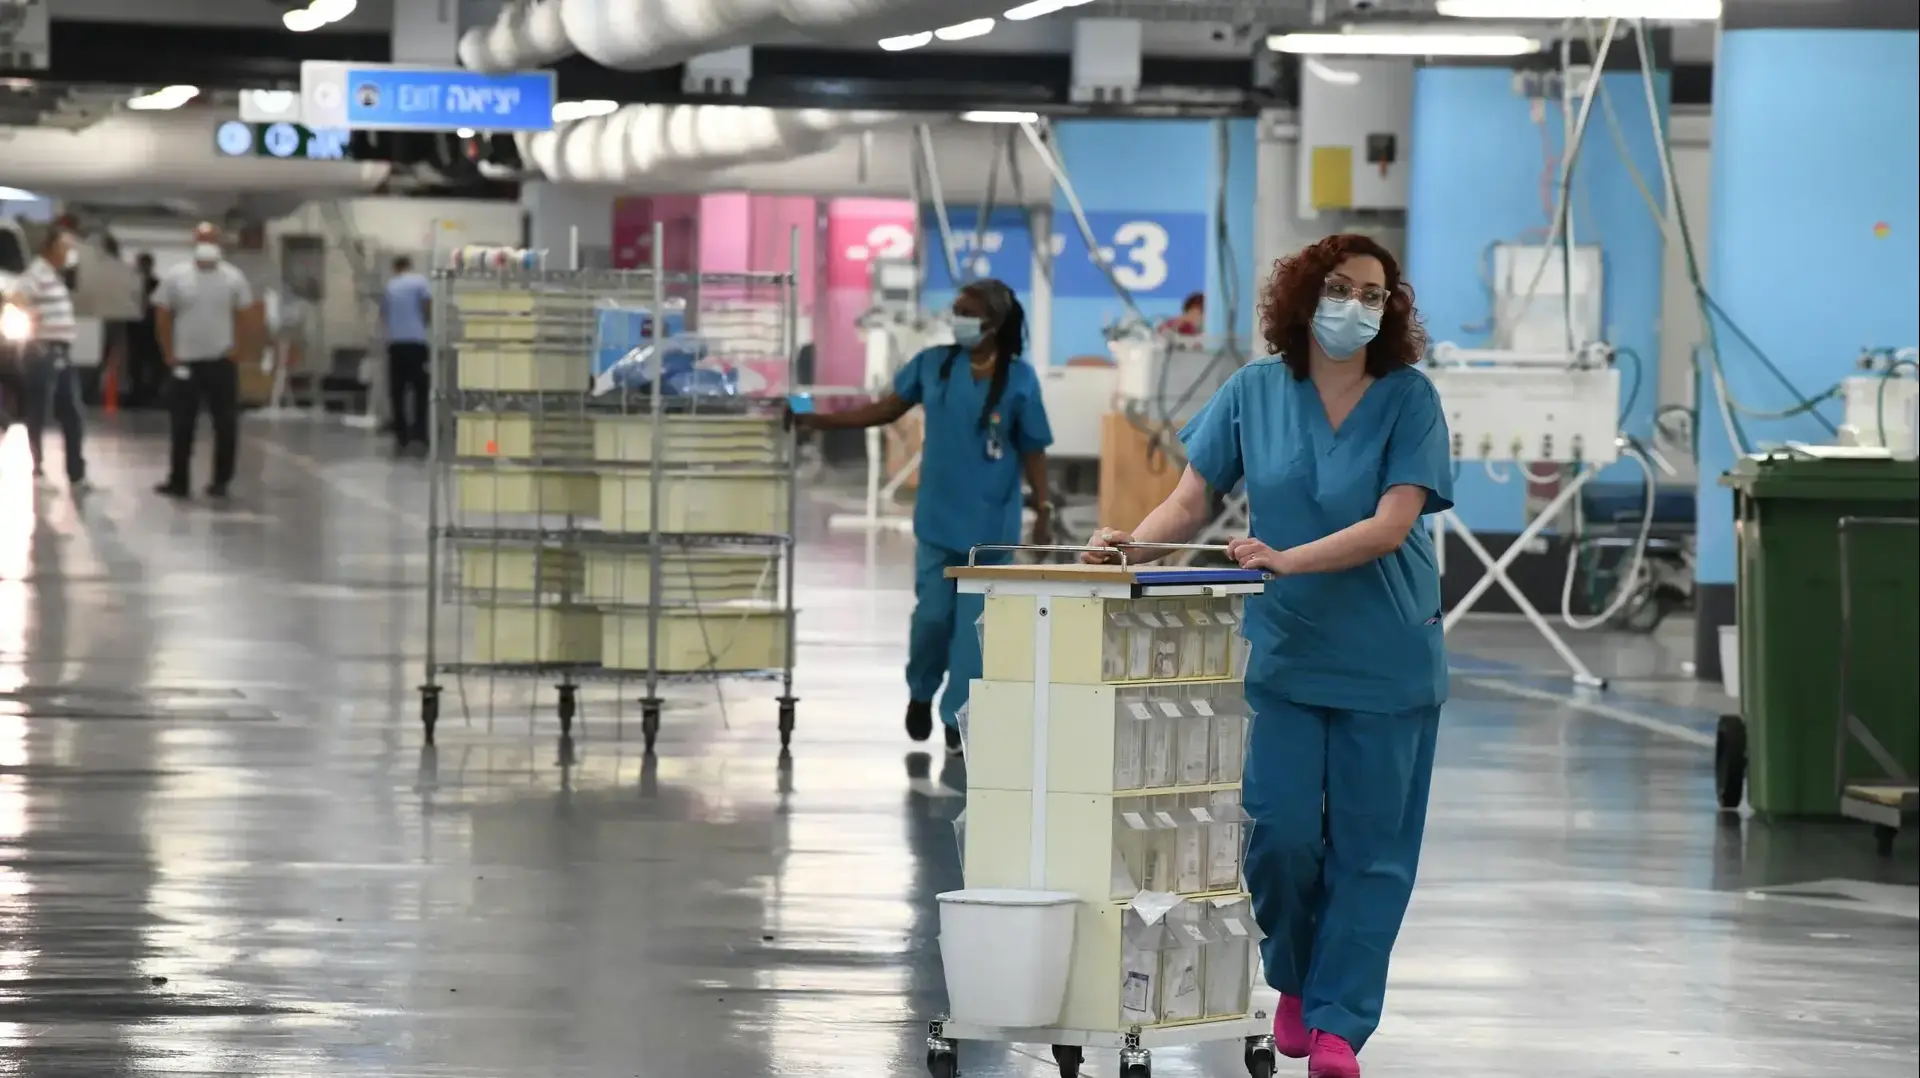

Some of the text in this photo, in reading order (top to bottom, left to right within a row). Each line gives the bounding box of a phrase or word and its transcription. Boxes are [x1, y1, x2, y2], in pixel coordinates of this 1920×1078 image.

[397, 84, 521, 115] EXIT יציאה
[1087, 220, 1170, 292] -3
